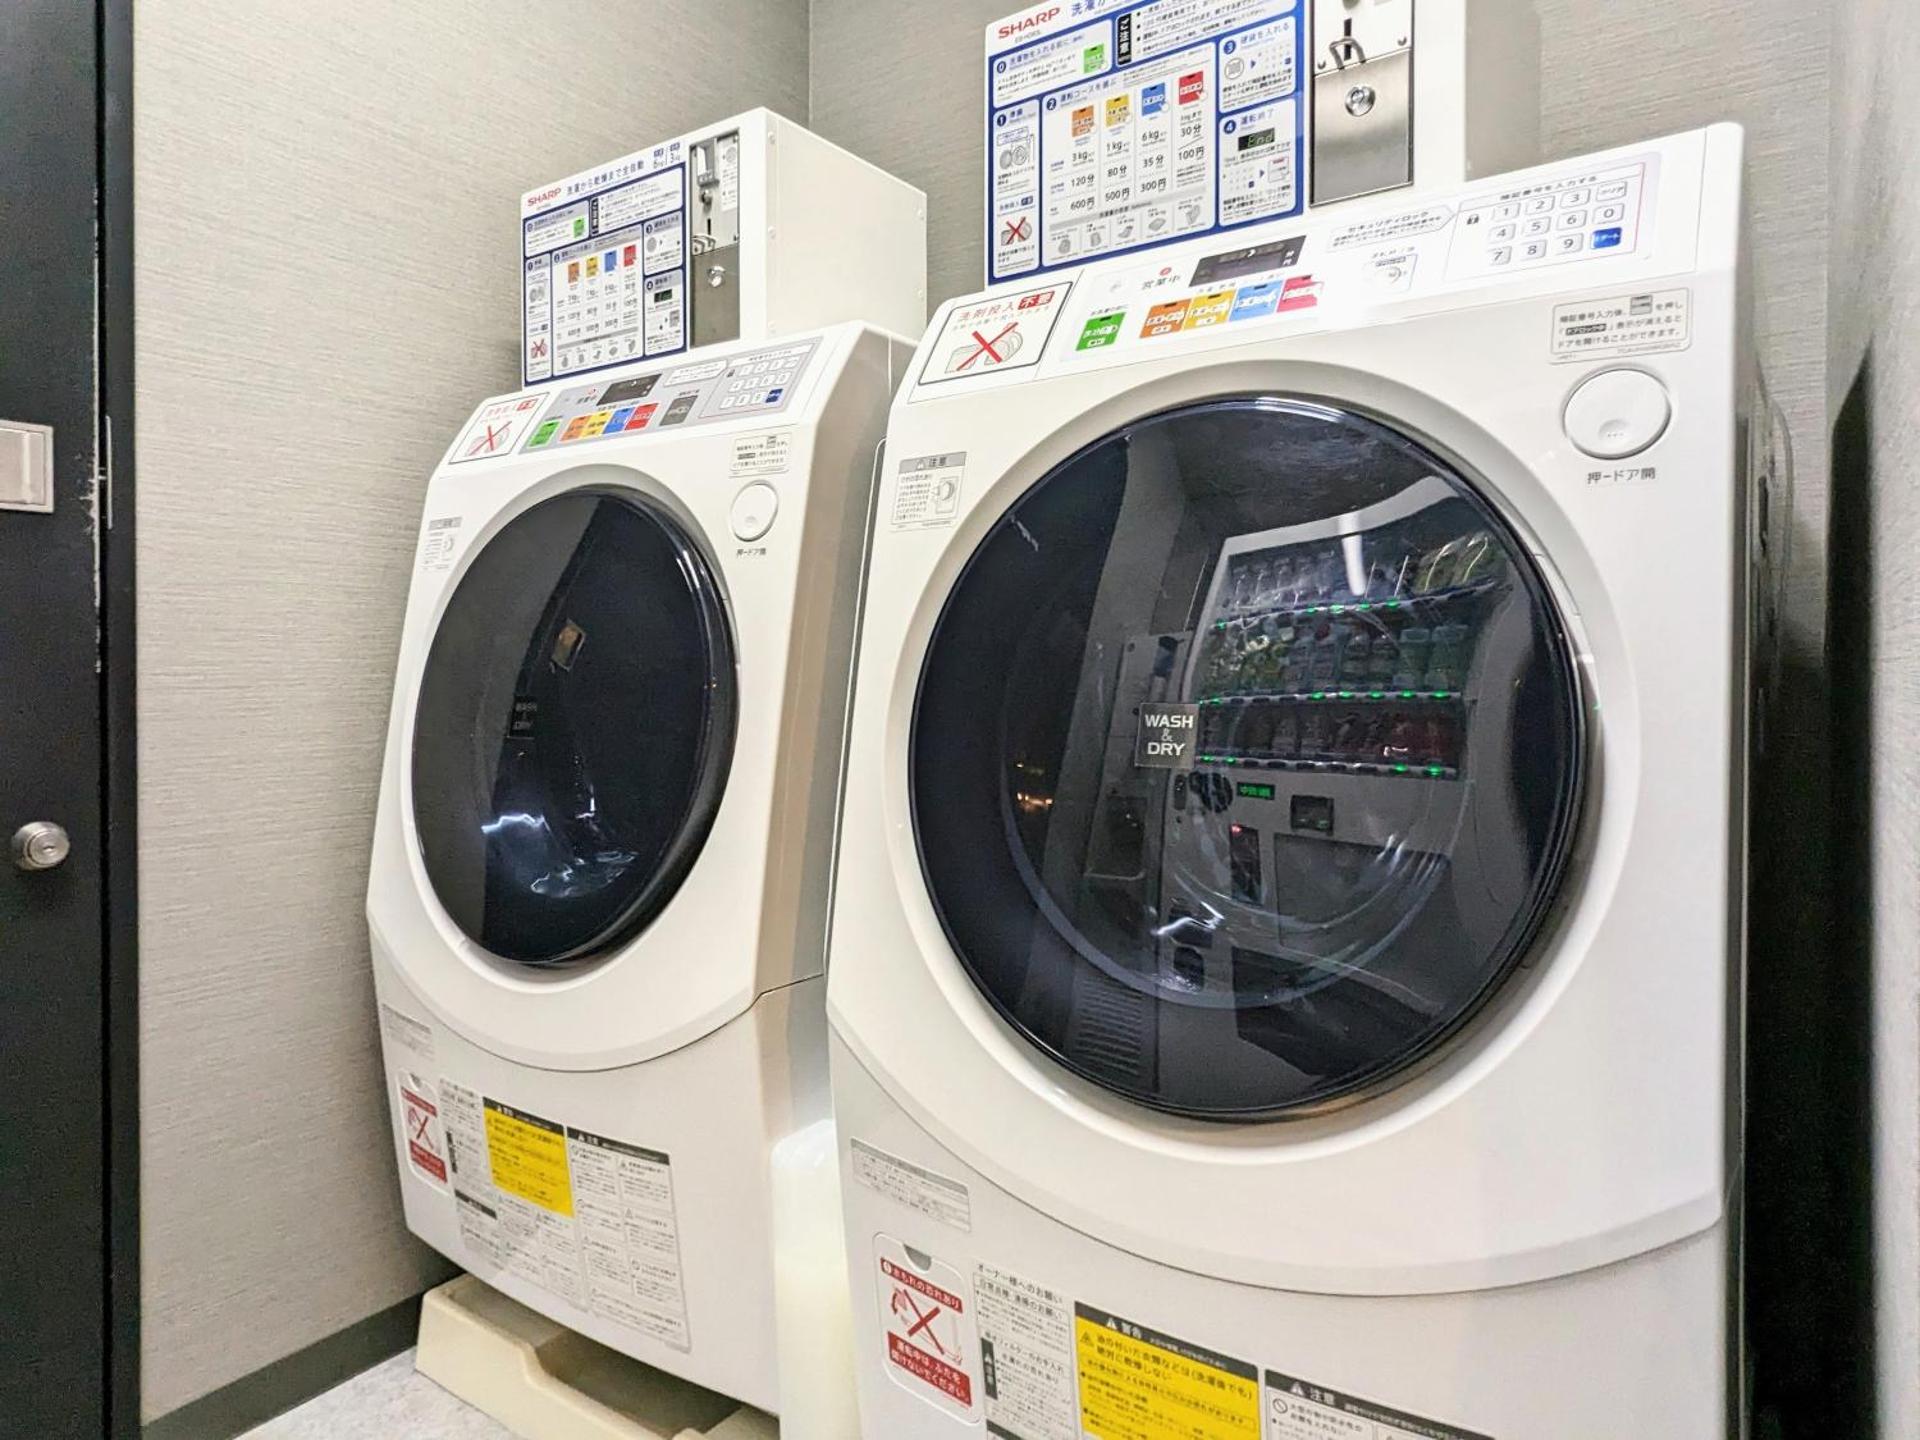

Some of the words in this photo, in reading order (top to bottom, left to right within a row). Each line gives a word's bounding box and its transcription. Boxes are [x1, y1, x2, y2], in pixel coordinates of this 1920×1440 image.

[998, 7, 1060, 39] SHARP
[1178, 146, 1204, 161] 100円
[1071, 174, 1095, 188] 120分
[1140, 178, 1167, 193] 300円
[527, 187, 561, 206] SHARP
[1105, 187, 1130, 202] 500円
[1070, 197, 1095, 211] 600円
[1503, 207, 1510, 217] 1
[1534, 200, 1545, 211] 2
[1570, 193, 1581, 204] 3
[1496, 228, 1507, 239] 4
[1531, 221, 1542, 233] 5
[1566, 214, 1577, 226] 6
[1492, 250, 1503, 262] 7
[1526, 244, 1537, 256] 8
[1563, 237, 1574, 250] 9
[1144, 713, 1194, 729] WASH
[1160, 728, 1174, 742] &
[1147, 741, 1186, 757] DRY
[977, 1262, 1063, 1303] オーナー様へのお願い
[1309, 1387, 1336, 1406] 注意
